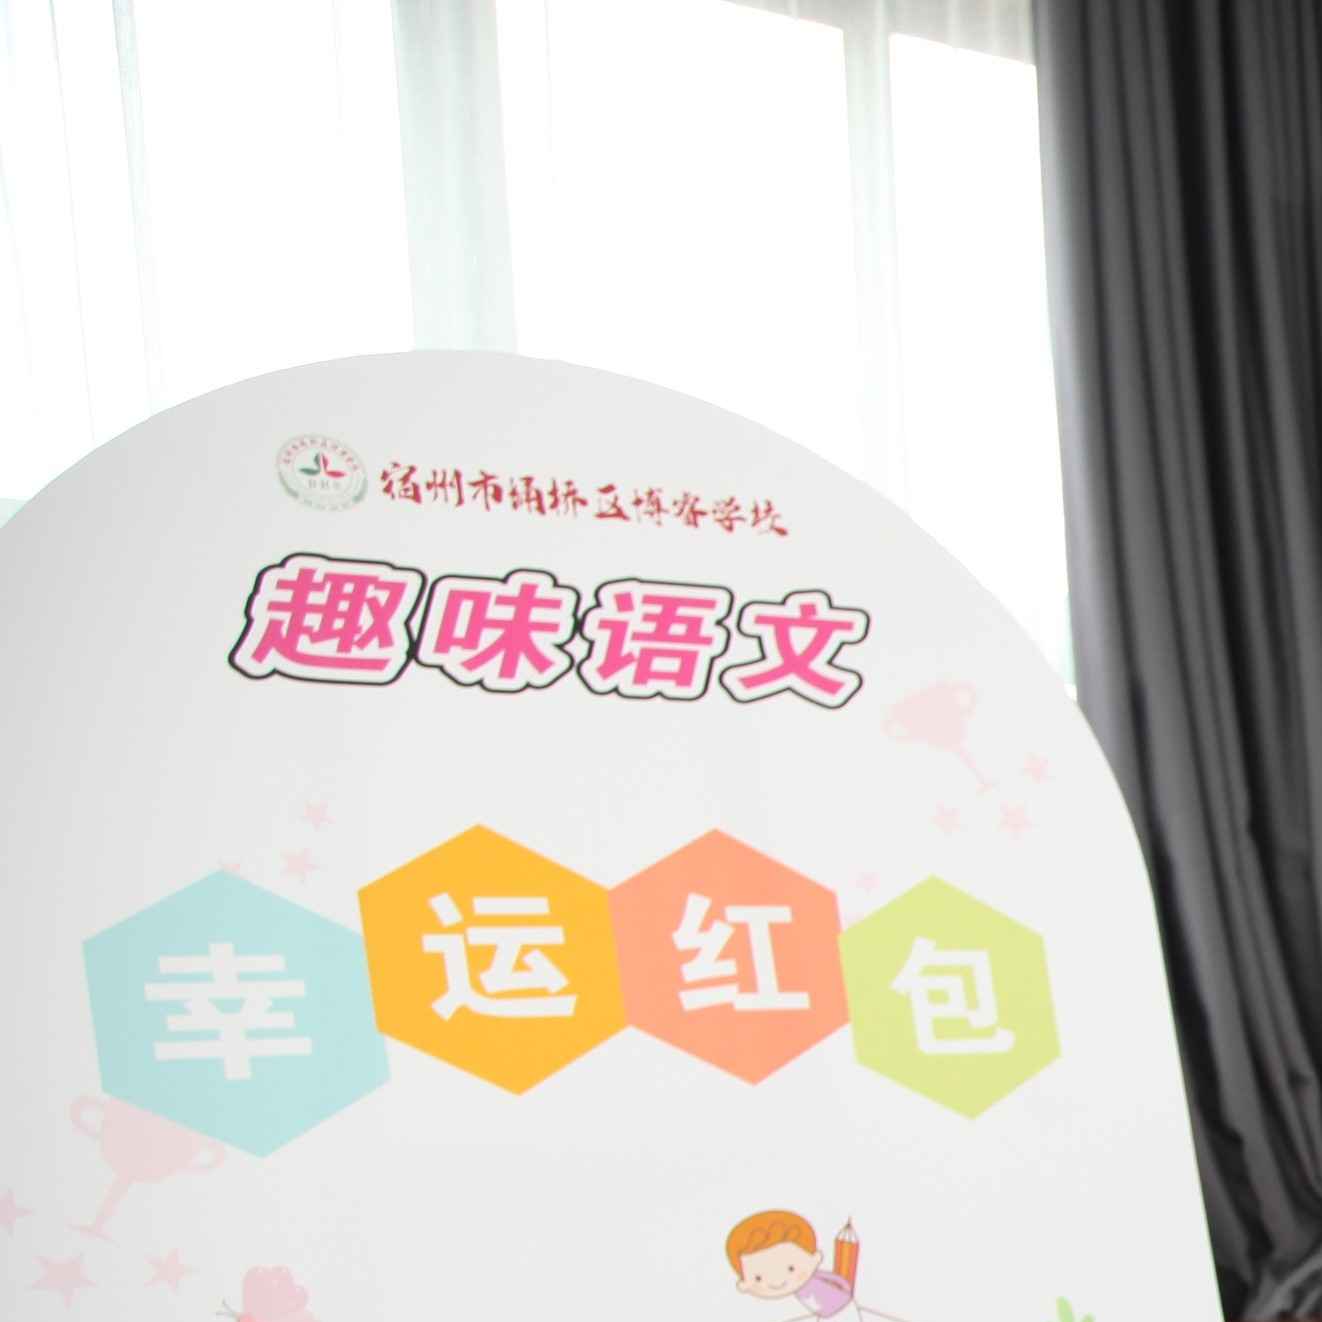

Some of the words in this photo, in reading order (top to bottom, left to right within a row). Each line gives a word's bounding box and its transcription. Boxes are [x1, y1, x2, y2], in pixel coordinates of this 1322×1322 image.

[251, 566, 856, 697] 趣味语文
[143, 890, 1016, 1082] 幸运红包
